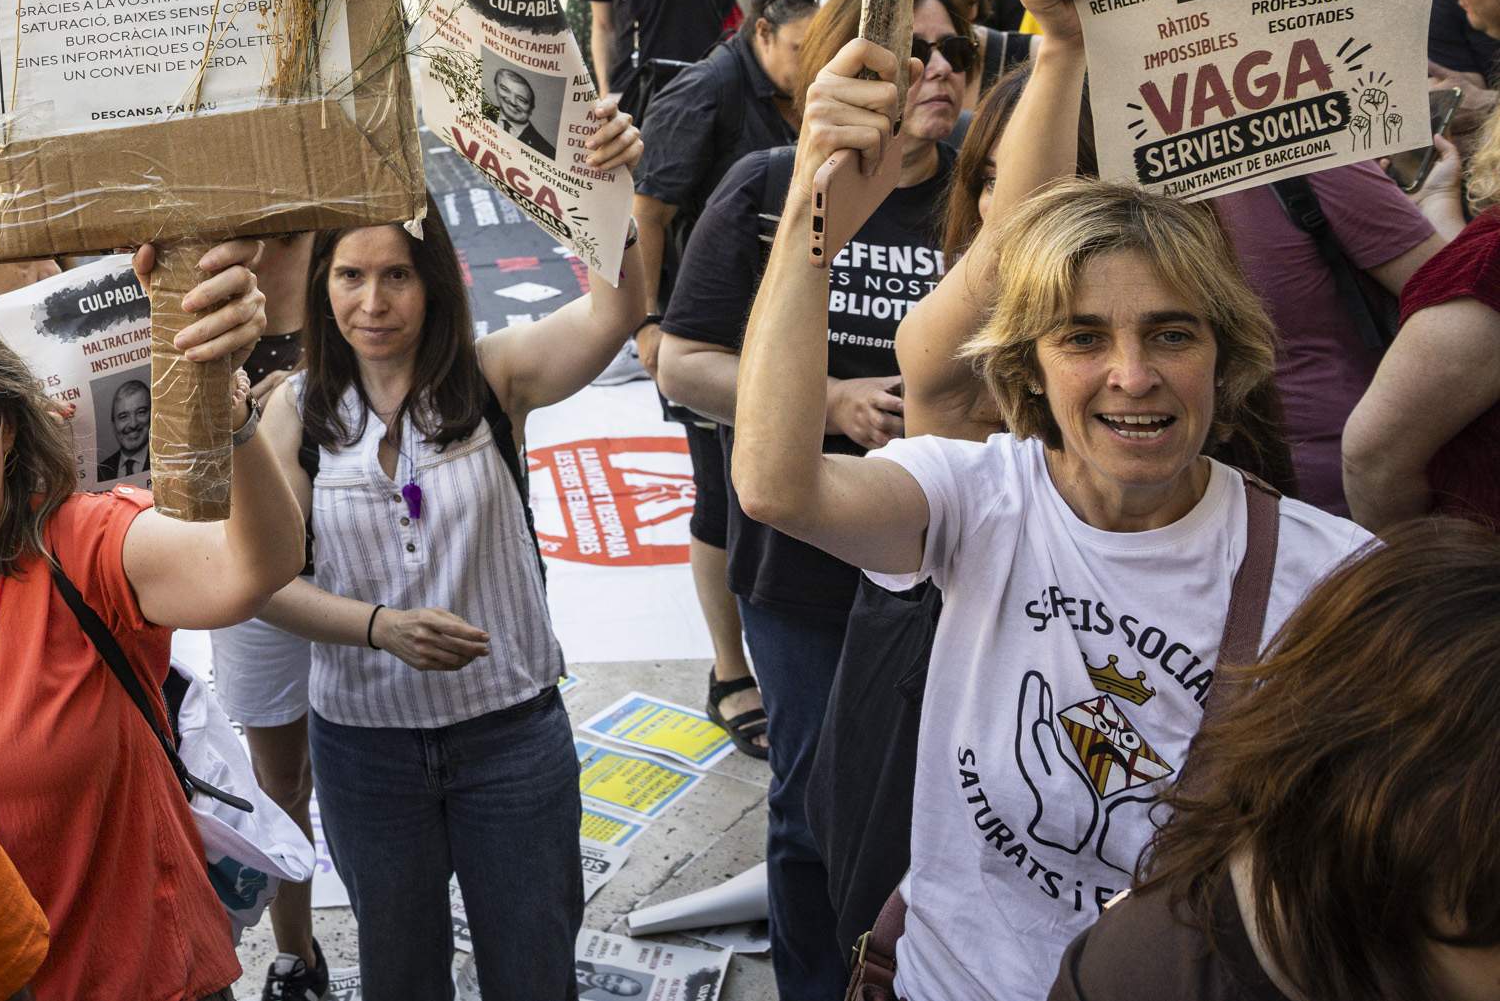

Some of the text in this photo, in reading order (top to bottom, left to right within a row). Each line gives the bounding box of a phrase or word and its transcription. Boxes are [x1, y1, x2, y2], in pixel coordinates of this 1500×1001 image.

[16, 1, 81, 18] GRÀCIES
[84, 0, 95, 11] A
[21, 13, 110, 34] SATURACIÓ,
[114, 10, 166, 25] BAIXES
[170, 6, 219, 20] SENSE
[1268, 8, 1355, 34] ESGOTADES
[65, 21, 239, 47] BUROCRÀCIA INFINITA,
[481, 21, 566, 55] MALTRACTAMENT
[1157, 11, 1210, 40] RÀTIOS
[15, 55, 58, 70] EINES
[61, 41, 190, 65] INFORMÀTIQUES
[484, 36, 561, 71] INSTITUCIONAL
[1144, 32, 1239, 71] IMPOSSIBLES
[63, 55, 247, 82] UN CONVENI DE MERDA
[1138, 38, 1335, 136] VAGA
[91, 106, 163, 121] DESCANSA
[166, 104, 186, 116] EN
[1145, 98, 1343, 178] SERVEIS SOCIALS
[451, 127, 563, 221] VAGA
[521, 149, 593, 190] PROFESSIONALS
[573, 153, 588, 165] QU
[1162, 140, 1332, 197] AJUNTAMENT DE BARCELONA
[530, 164, 580, 198] ESGOTADES
[570, 165, 616, 184] ARRIBEN
[511, 193, 568, 237] SOCIALS
[865, 275, 937, 295] NOST
[82, 326, 151, 356] MALTRACTAME
[957, 746, 1063, 900] SATURATS
